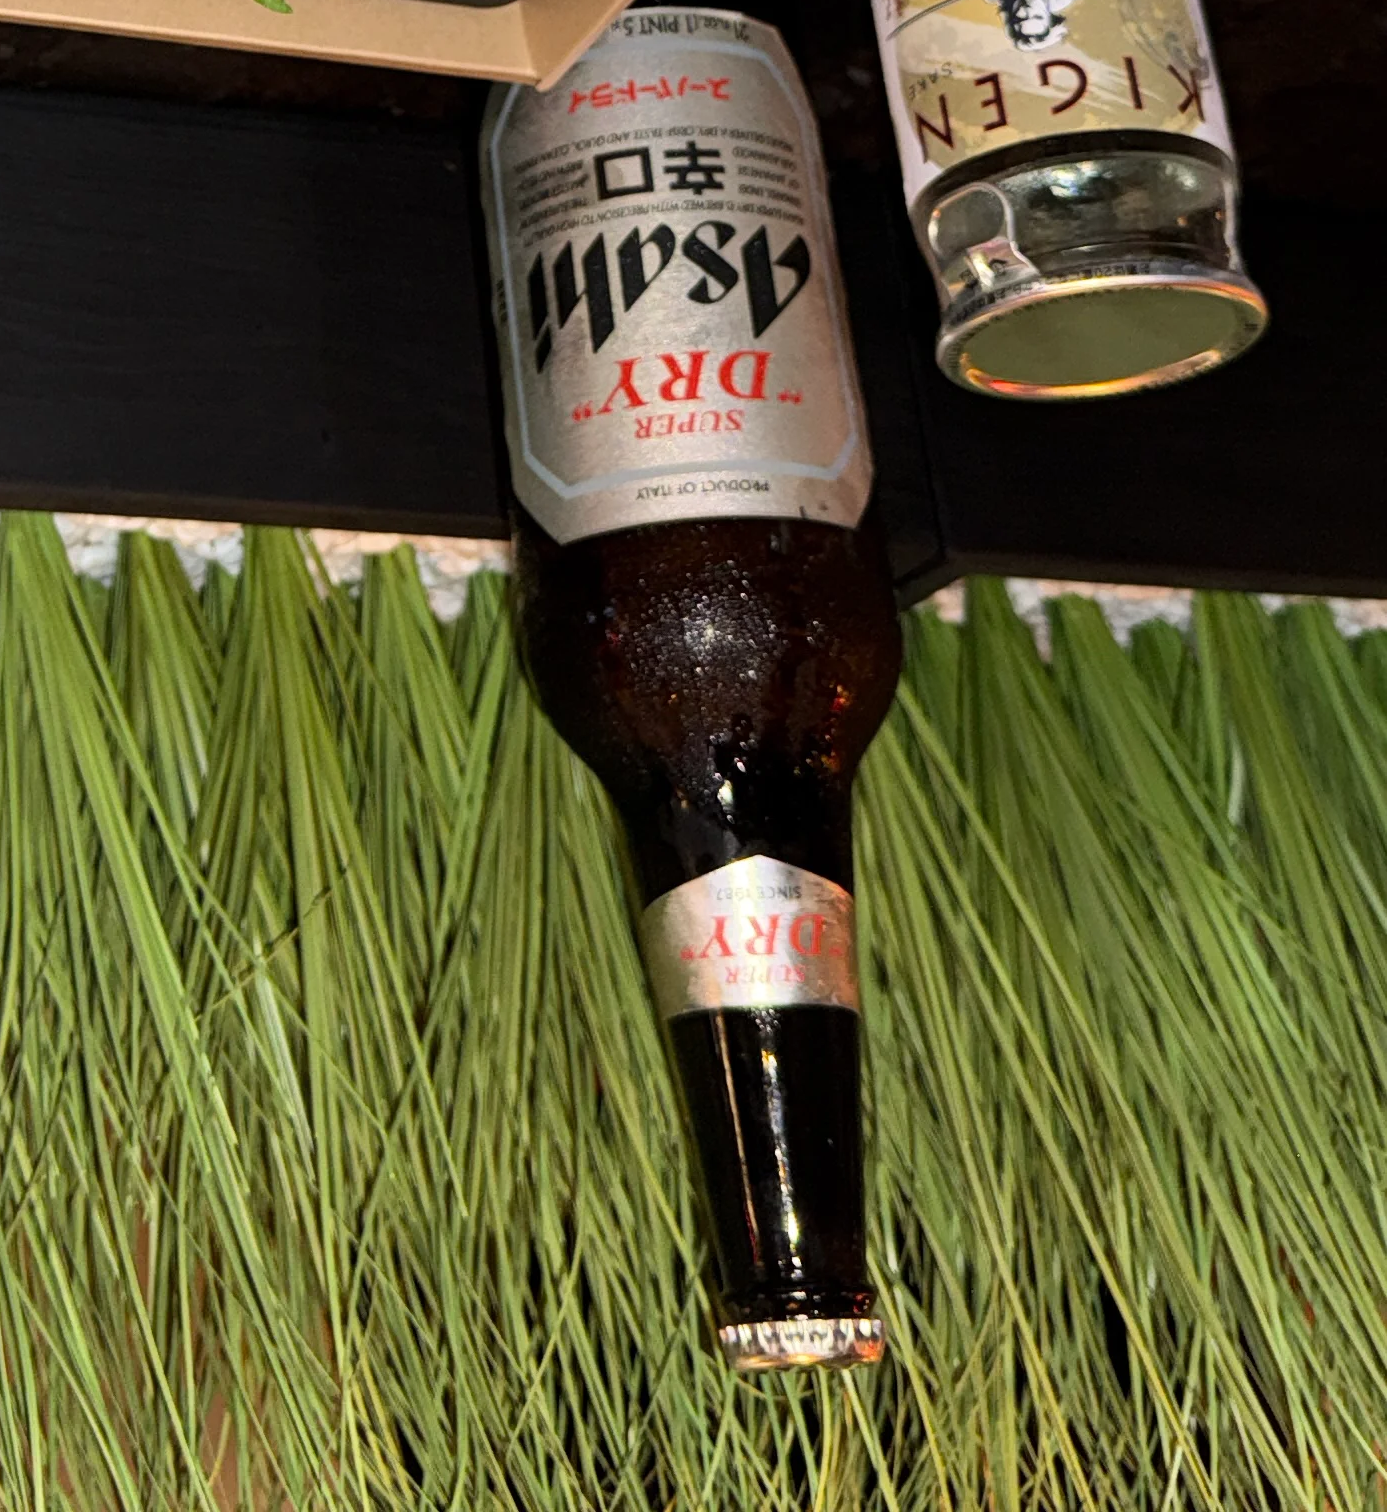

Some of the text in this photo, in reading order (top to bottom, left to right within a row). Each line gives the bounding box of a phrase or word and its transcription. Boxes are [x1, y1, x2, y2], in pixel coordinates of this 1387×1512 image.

[639, 14, 680, 35] PINT
[907, 62, 954, 101] SAKE
[567, 76, 731, 115] スーパードライ
[913, 57, 1205, 165] KIGEN
[607, 131, 630, 143] AND
[634, 128, 662, 140] TASTE
[592, 140, 725, 201] 辛口
[597, 203, 649, 223] PRECISION
[651, 199, 679, 213] WITH
[681, 199, 724, 211] BREWED
[581, 214, 595, 226] TO
[527, 221, 810, 374] Asahi
[633, 409, 744, 440] SUPER
[635, 479, 770, 501] PRODUCT OF ITALY
[756, 885, 802, 900] SINCE
[724, 963, 806, 984] SUPER
